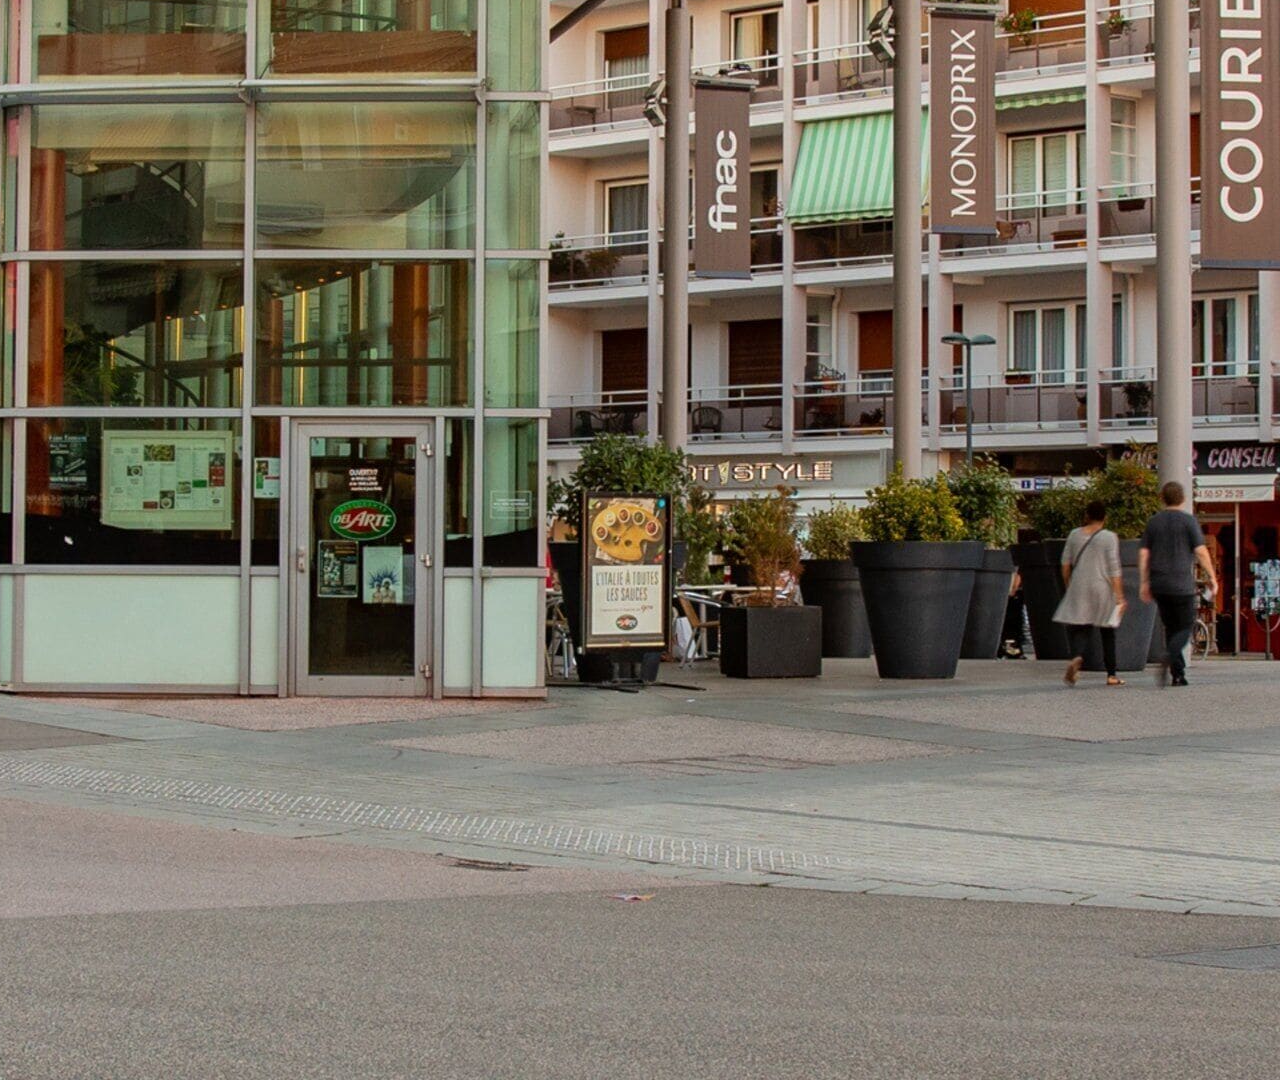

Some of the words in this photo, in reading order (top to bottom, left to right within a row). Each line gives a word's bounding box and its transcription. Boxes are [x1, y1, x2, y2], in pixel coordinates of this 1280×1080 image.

[950, 29, 977, 218] MONOPRIX
[708, 129, 738, 233] fnac
[1207, 447, 1276, 469] CONSEIL
[734, 461, 832, 482] STYLE
[339, 510, 392, 532] ARTE
[633, 571, 659, 586] TOUTES
[607, 587, 619, 601] LES
[621, 587, 648, 601] SAUCES
